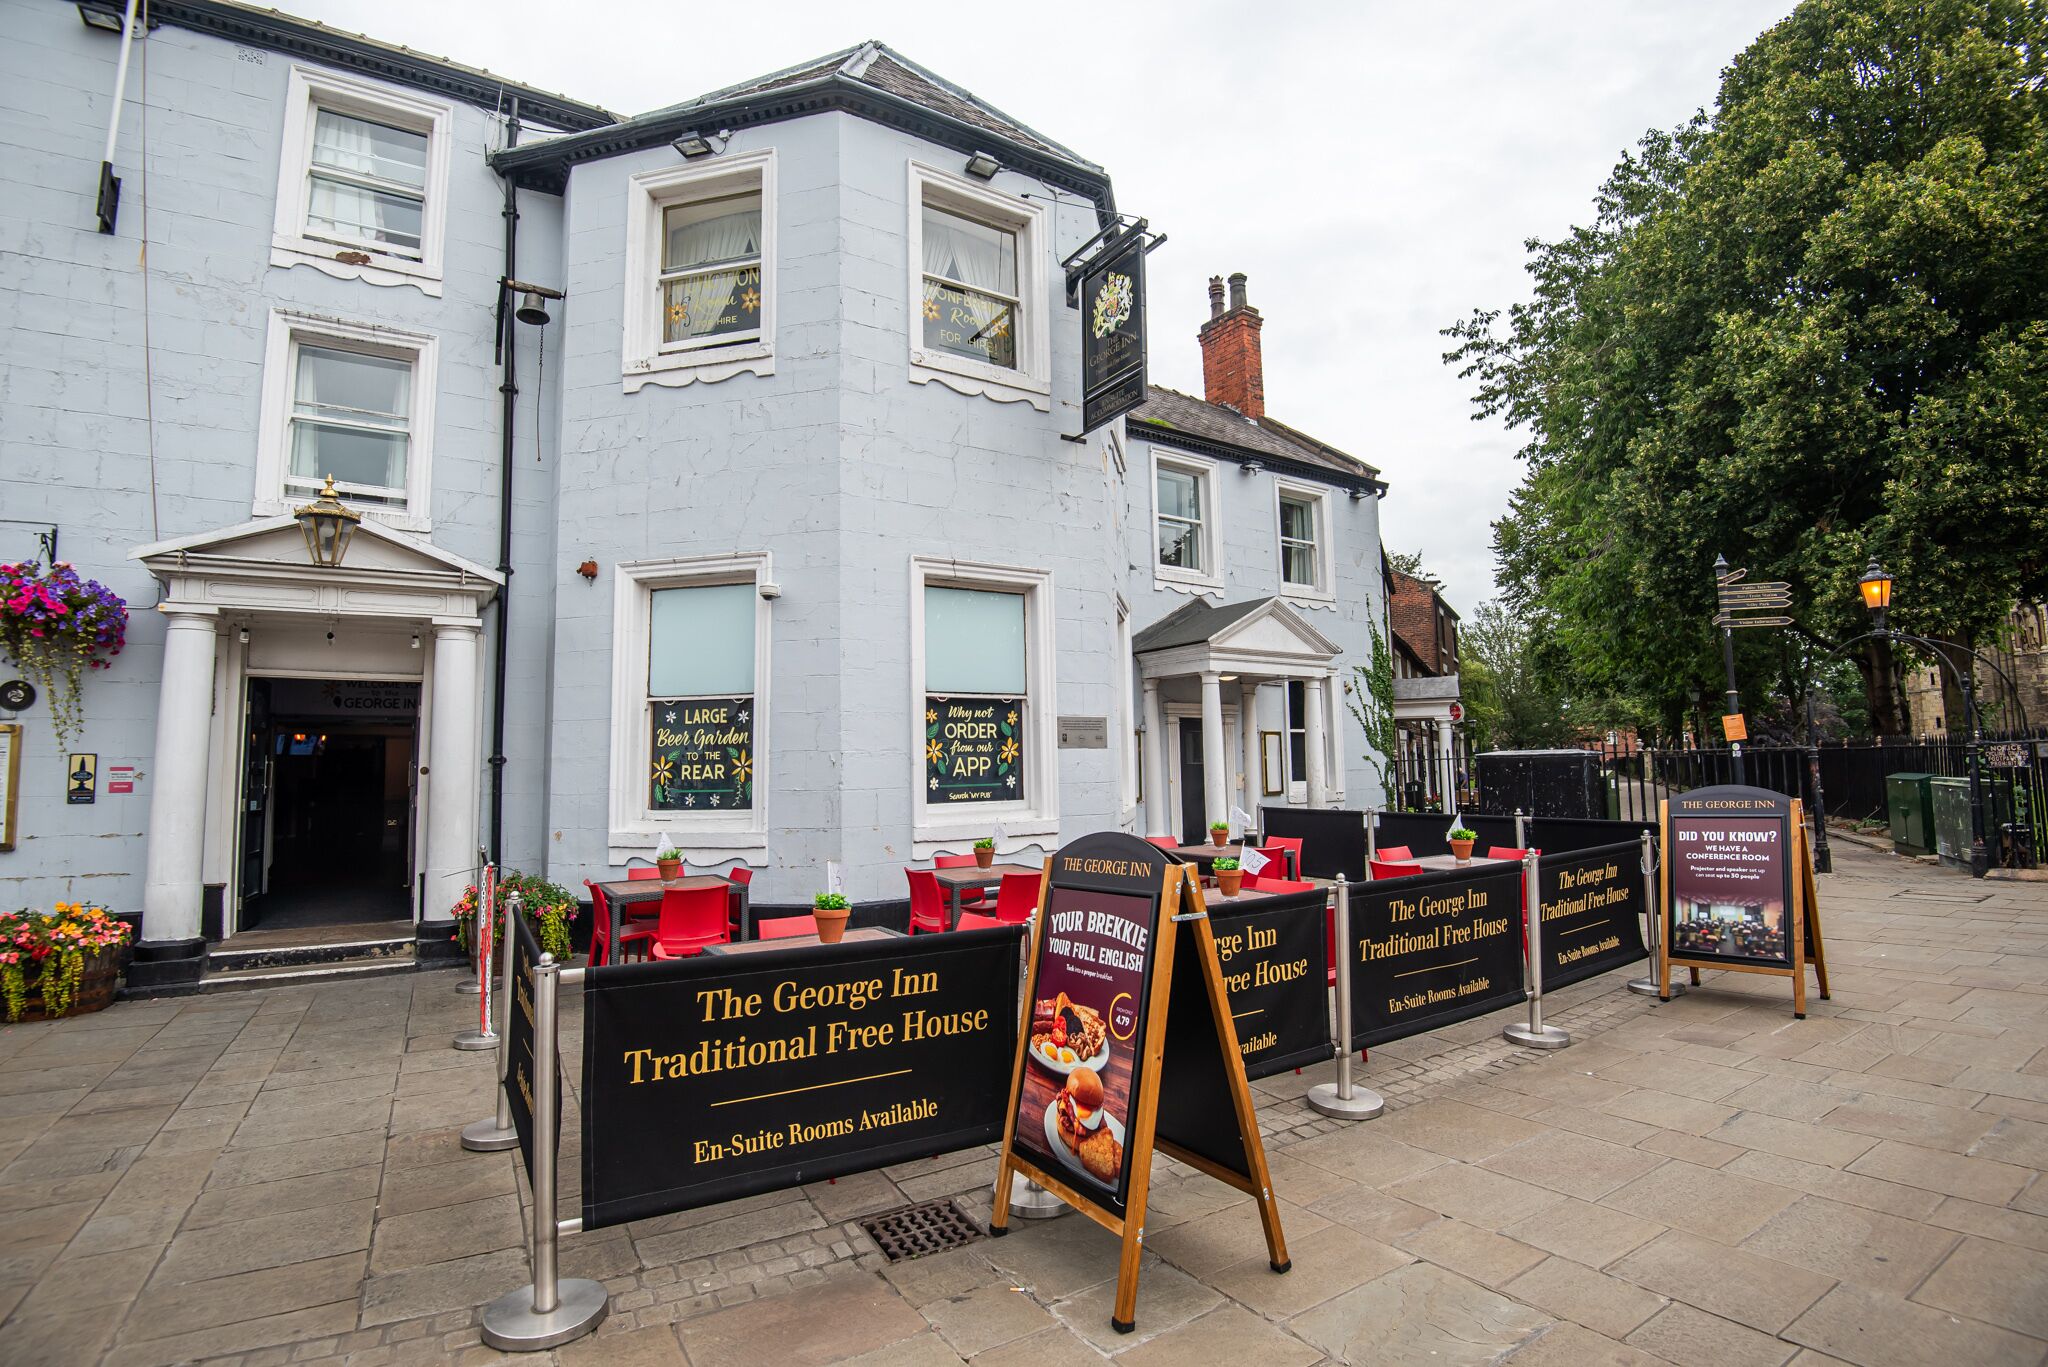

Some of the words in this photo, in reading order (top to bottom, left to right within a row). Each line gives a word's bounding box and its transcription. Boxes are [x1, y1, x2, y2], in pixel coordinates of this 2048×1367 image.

[716, 315, 738, 325] HIRE
[940, 329, 961, 344] FOR
[1107, 334, 1119, 346] THE
[1089, 341, 1121, 367] GEORGE
[1121, 331, 1137, 348] INN
[344, 698, 401, 709] GEORGE
[948, 706, 972, 722] Why
[974, 706, 994, 718] not
[685, 708, 728, 724] LARGE
[657, 728, 690, 747] Beer
[694, 727, 750, 751] Garden
[944, 723, 998, 739] ORDER
[686, 752, 699, 760] TO
[704, 751, 721, 760] THE
[950, 740, 974, 756] from
[976, 742, 994, 752] our
[681, 764, 725, 780] REAR
[952, 757, 991, 777] APP
[1682, 801, 1703, 809] THE
[1705, 801, 1752, 809] GEORGE
[1679, 831, 1698, 841] DID
[1701, 831, 1725, 841] YOU
[1729, 831, 1777, 842] KNOW?
[1063, 857, 1082, 872] THE
[1084, 857, 1128, 876] GEORGE
[1129, 862, 1152, 878] INN
[1686, 853, 1740, 861] CONFERENCE
[1559, 870, 1575, 890] The
[1577, 867, 1604, 886] George
[1605, 862, 1618, 880] Inn
[1389, 900, 1415, 923] The
[1419, 895, 1465, 918] George
[1467, 888, 1488, 909] Inn
[1540, 893, 1587, 922] Traditional
[1588, 891, 1606, 910] Free
[1606, 886, 1629, 905] House
[1051, 910, 1084, 934] YOUR
[1087, 911, 1148, 952] BREKKIE
[1246, 925, 1277, 951] Inn
[1359, 926, 1439, 962] Traditional
[1443, 924, 1471, 947] Free
[1473, 917, 1508, 940] House
[1049, 936, 1072, 957] YOUR
[1072, 941, 1096, 962] FULL
[1098, 947, 1144, 973] ENGLISH
[1557, 947, 1582, 965] En-Suite
[1581, 943, 1599, 958] Rooms
[1083, 969, 1096, 978] proper
[1223, 971, 1250, 994] ree
[1254, 958, 1308, 988] House
[696, 987, 762, 1023] The
[773, 979, 883, 1013] George
[892, 968, 939, 998] Inn
[1388, 992, 1427, 1014] En-Suite
[1428, 986, 1456, 1004] Rooms
[1458, 977, 1490, 997] Available
[1115, 1014, 1130, 1027] 4.79
[624, 1026, 817, 1084] Traditional
[825, 1018, 894, 1055] Free
[901, 1008, 989, 1043] House
[1238, 1031, 1277, 1055] vailable
[693, 1131, 784, 1164] En-Suite
[788, 1118, 854, 1146] Rooms
[858, 1097, 939, 1131] Available
